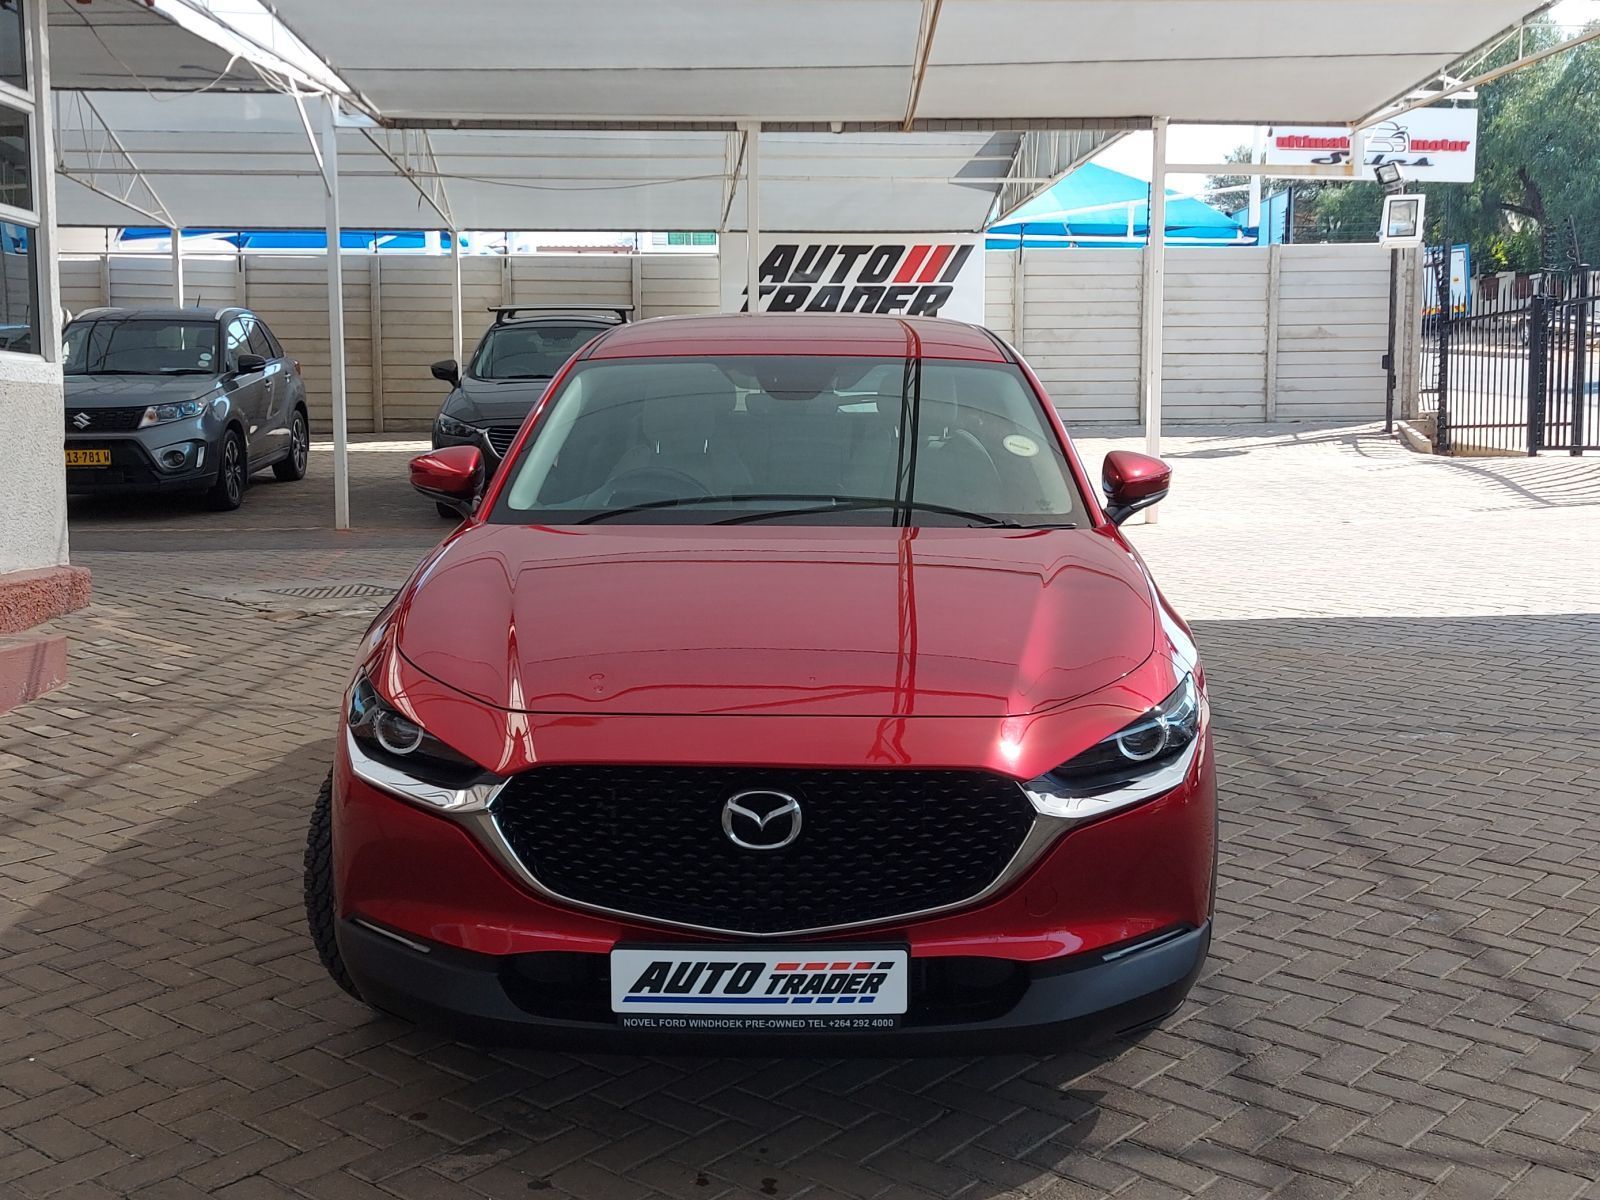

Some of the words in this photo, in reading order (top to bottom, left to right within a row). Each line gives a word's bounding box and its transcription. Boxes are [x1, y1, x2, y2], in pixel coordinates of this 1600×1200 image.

[1276, 135, 1350, 148] ultimat
[1410, 138, 1470, 152] motor
[758, 244, 906, 283] AUTO
[627, 961, 766, 994] AUTO
[764, 972, 888, 995] TRADER
[623, 1018, 657, 1027] NOVEL
[659, 1018, 687, 1028] FORD
[688, 1019, 743, 1028] WINDHOEK
[745, 1019, 806, 1028] PRE-OWNED
[808, 1019, 827, 1028] TEL
[828, 1019, 851, 1028] +264
[853, 1019, 870, 1028] 292
[871, 1019, 894, 1027] 4000
